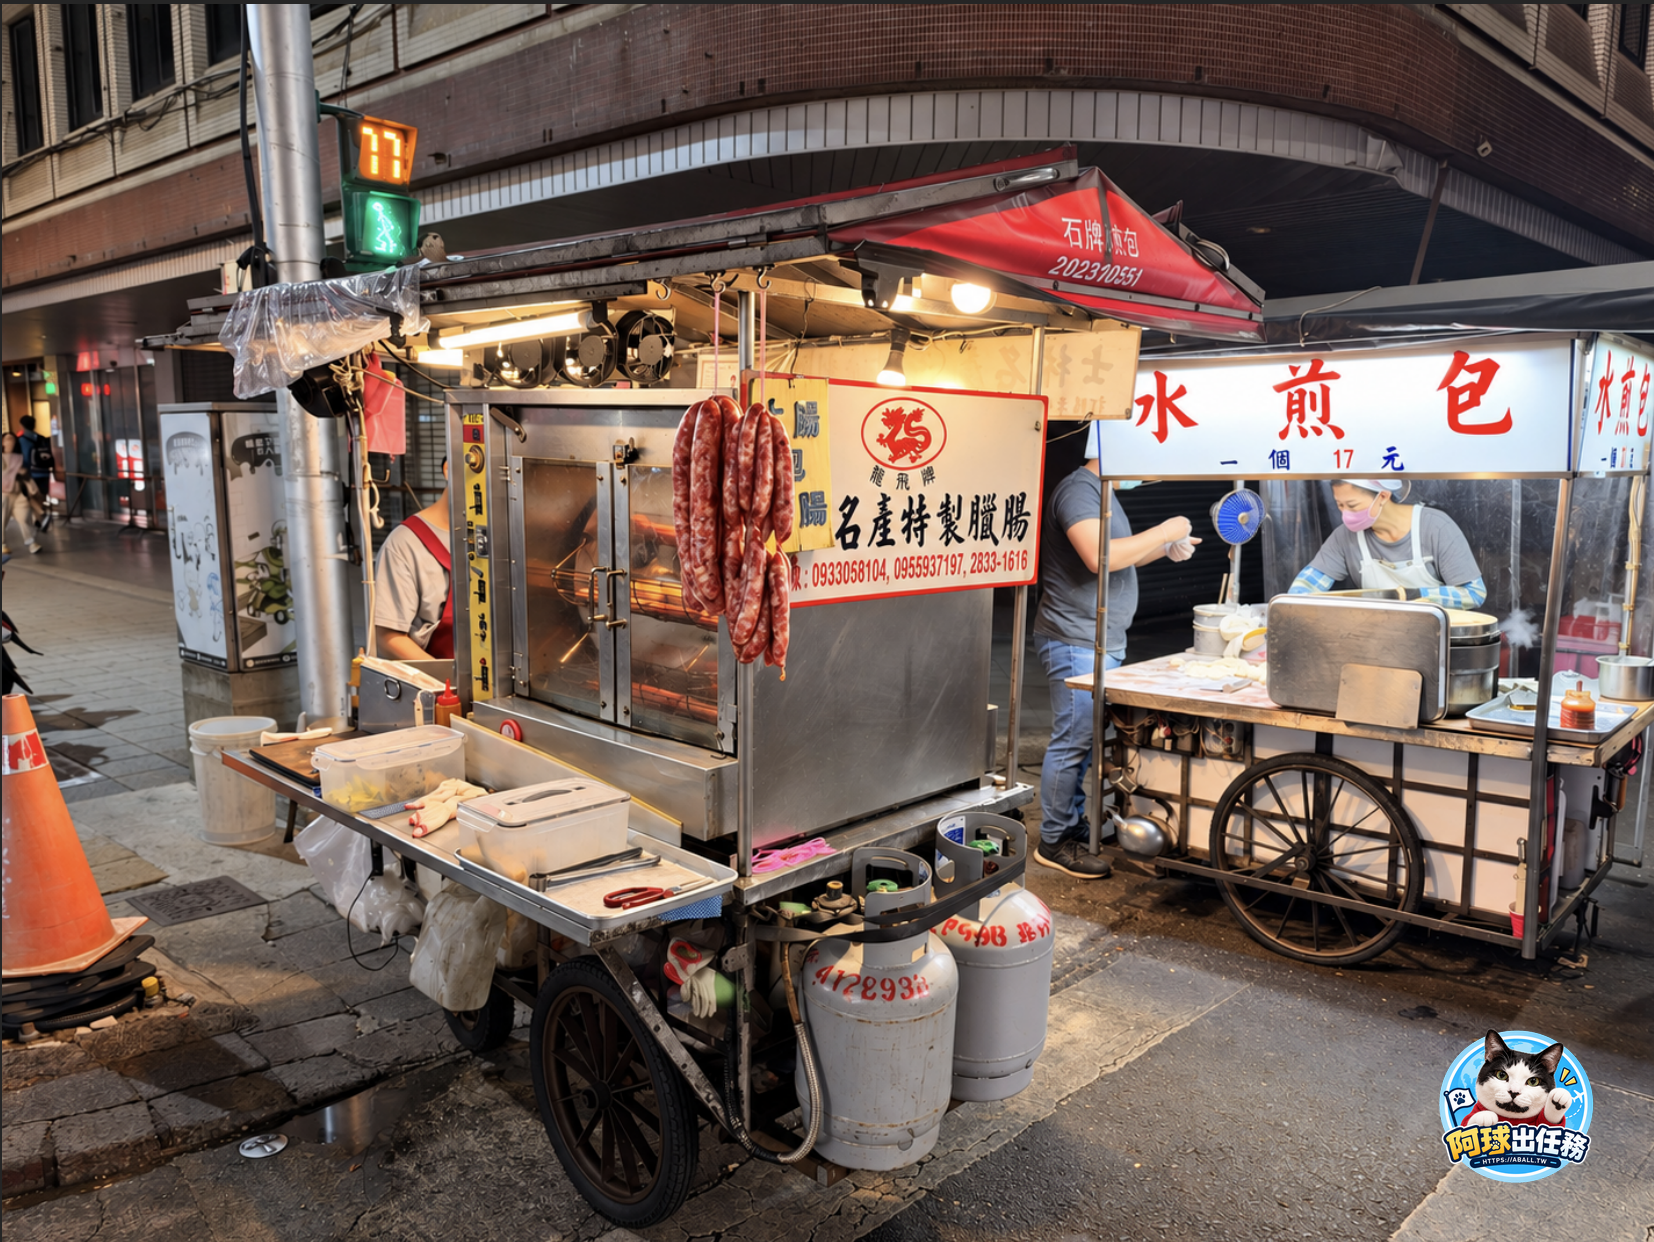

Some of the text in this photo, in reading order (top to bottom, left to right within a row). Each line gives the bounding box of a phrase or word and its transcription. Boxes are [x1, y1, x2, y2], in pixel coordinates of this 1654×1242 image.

[362, 126, 401, 179] 77
[1061, 217, 1139, 258] 石牌煎包
[1135, 350, 1513, 444] 水煎包
[869, 465, 937, 491] 龍飛牌
[970, 549, 1028, 574] 2833-1616
